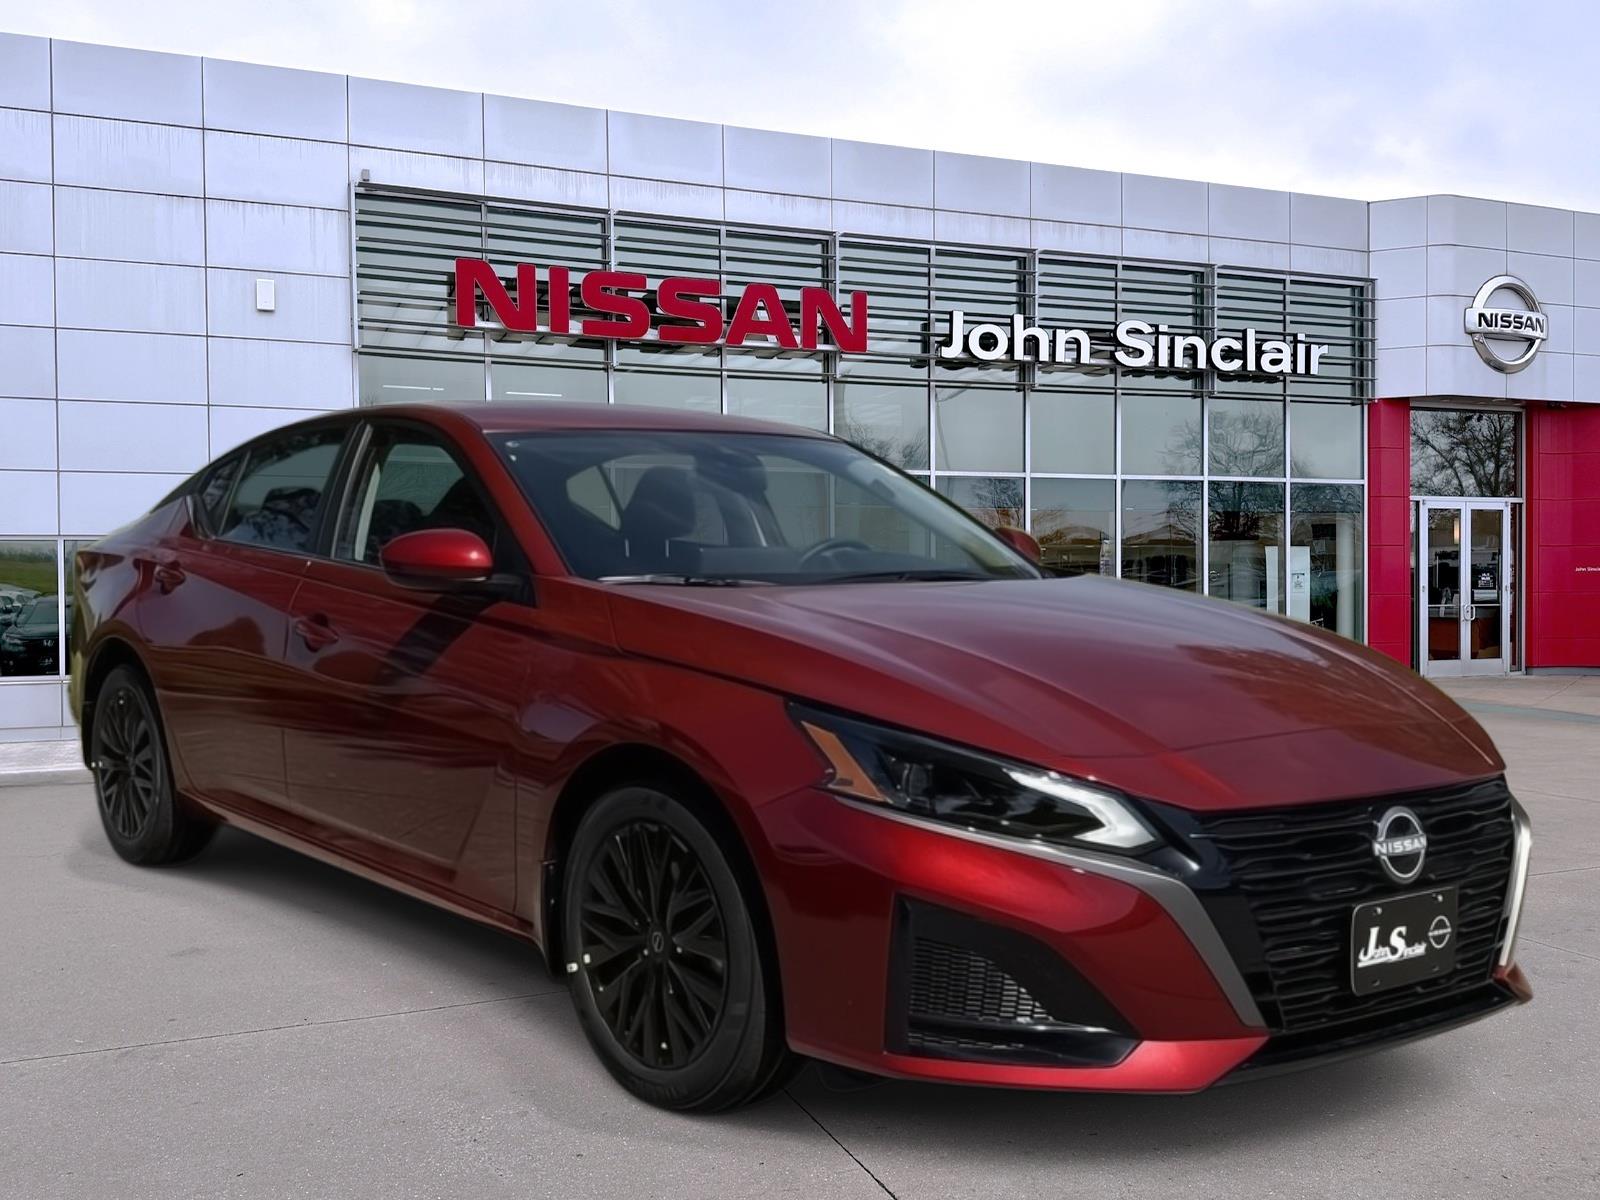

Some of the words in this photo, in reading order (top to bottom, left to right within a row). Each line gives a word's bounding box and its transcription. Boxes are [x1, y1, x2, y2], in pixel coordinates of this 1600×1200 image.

[455, 257, 868, 353] NISSAN
[1478, 312, 1544, 333] NISSAN
[941, 310, 1091, 364] John
[1114, 319, 1329, 375] Sinclair
[1374, 836, 1426, 856] NISSAN
